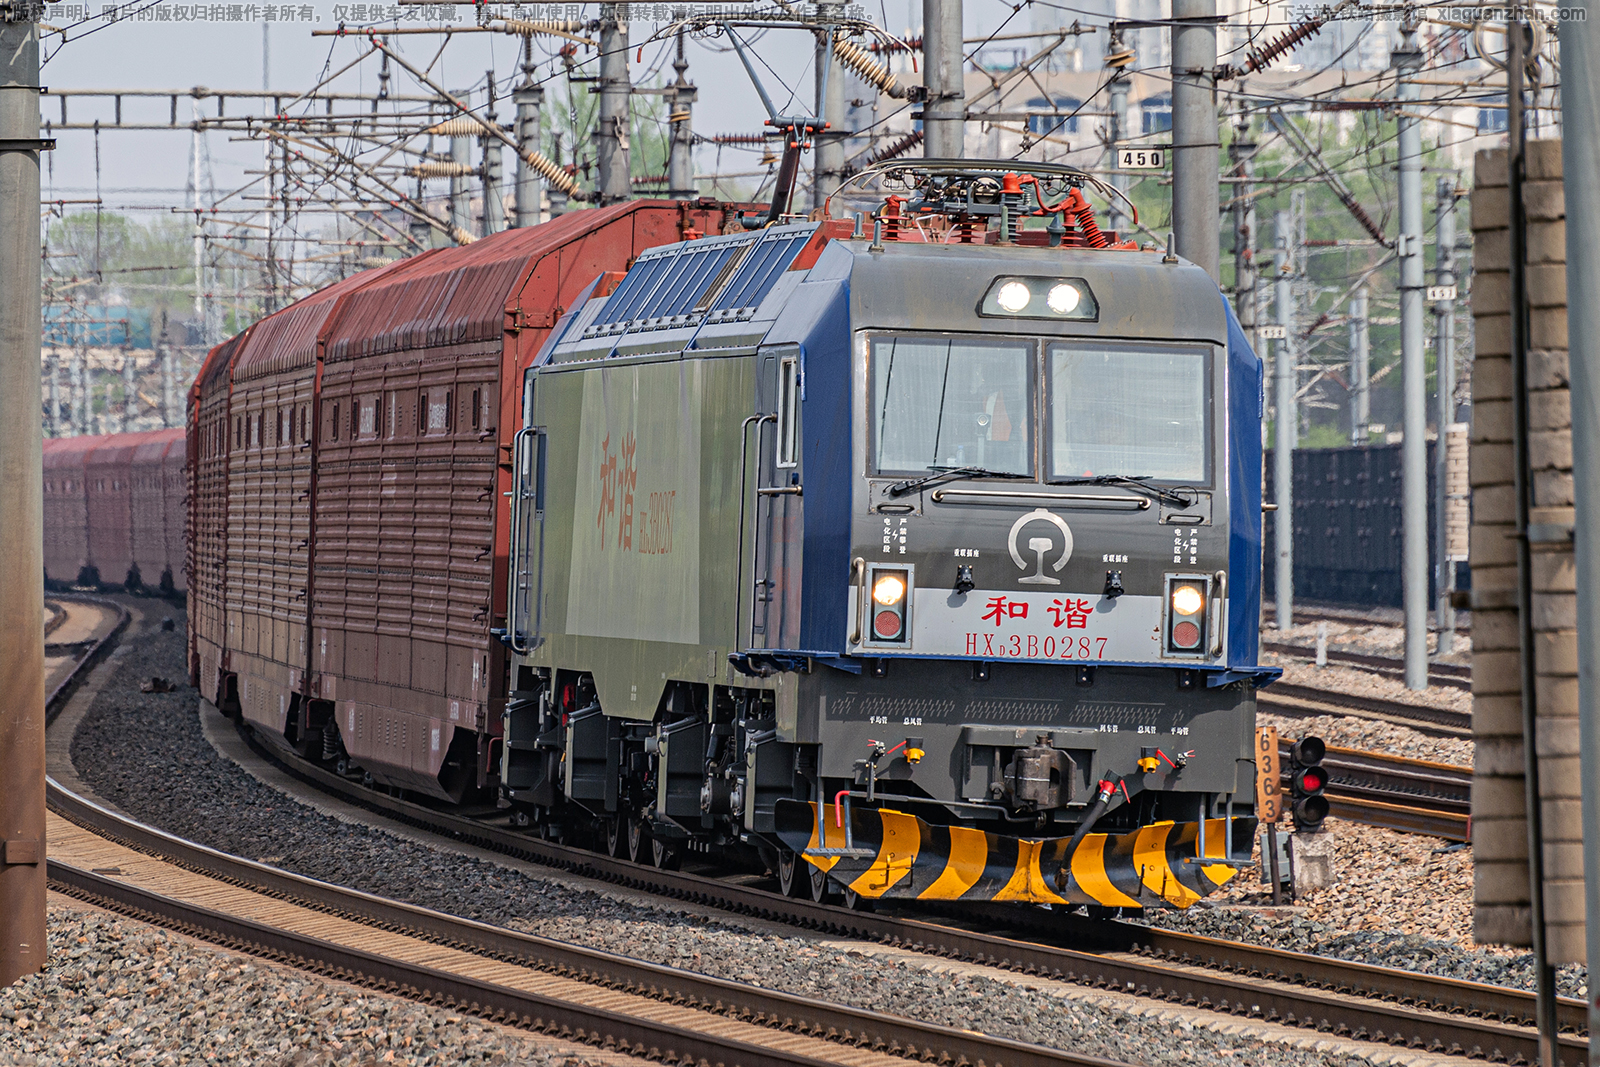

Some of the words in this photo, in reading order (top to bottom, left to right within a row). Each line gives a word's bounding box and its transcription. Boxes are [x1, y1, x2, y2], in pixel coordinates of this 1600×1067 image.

[1123, 152, 1160, 167] 450
[597, 430, 637, 552] 和谐
[882, 517, 894, 553] 电化区段
[1172, 528, 1183, 564] 电化区段
[982, 595, 1094, 630] 和谐
[965, 632, 1109, 660] HXD3B0287
[1259, 733, 1276, 819] 6363
